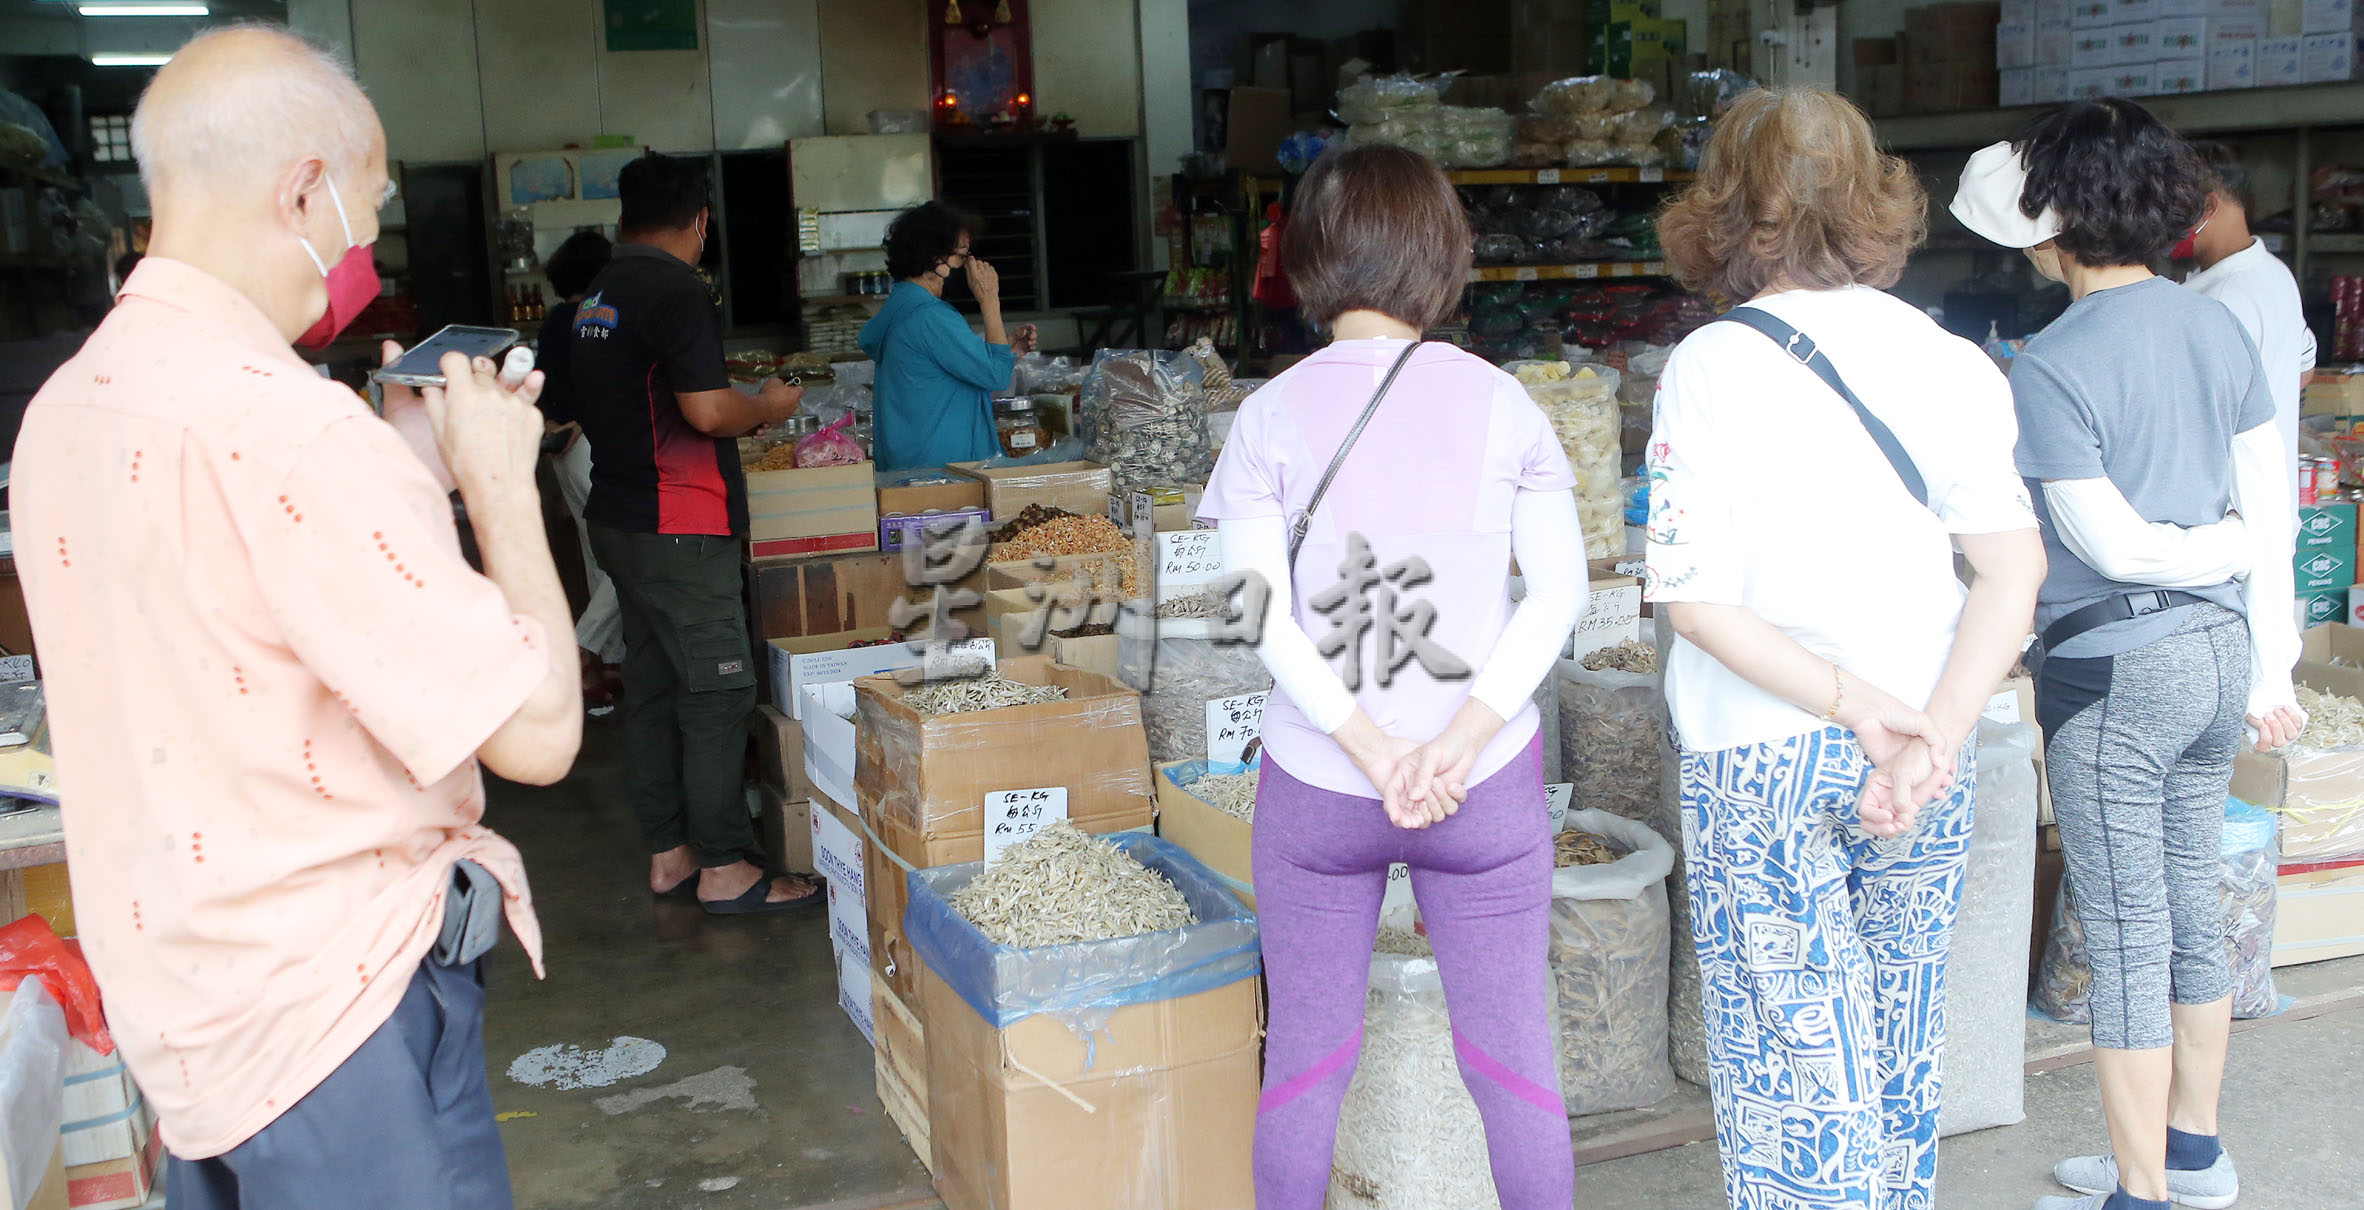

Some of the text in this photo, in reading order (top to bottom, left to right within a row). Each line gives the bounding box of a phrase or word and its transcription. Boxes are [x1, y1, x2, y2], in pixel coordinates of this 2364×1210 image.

[1165, 561, 1221, 574] RM 50.00
[1222, 695, 1264, 711] SE-KG
[1218, 728, 1235, 741] RM
[1003, 791, 1049, 804] SE-KG
[995, 822, 1012, 834] RM
[847, 865, 862, 888] HANG
